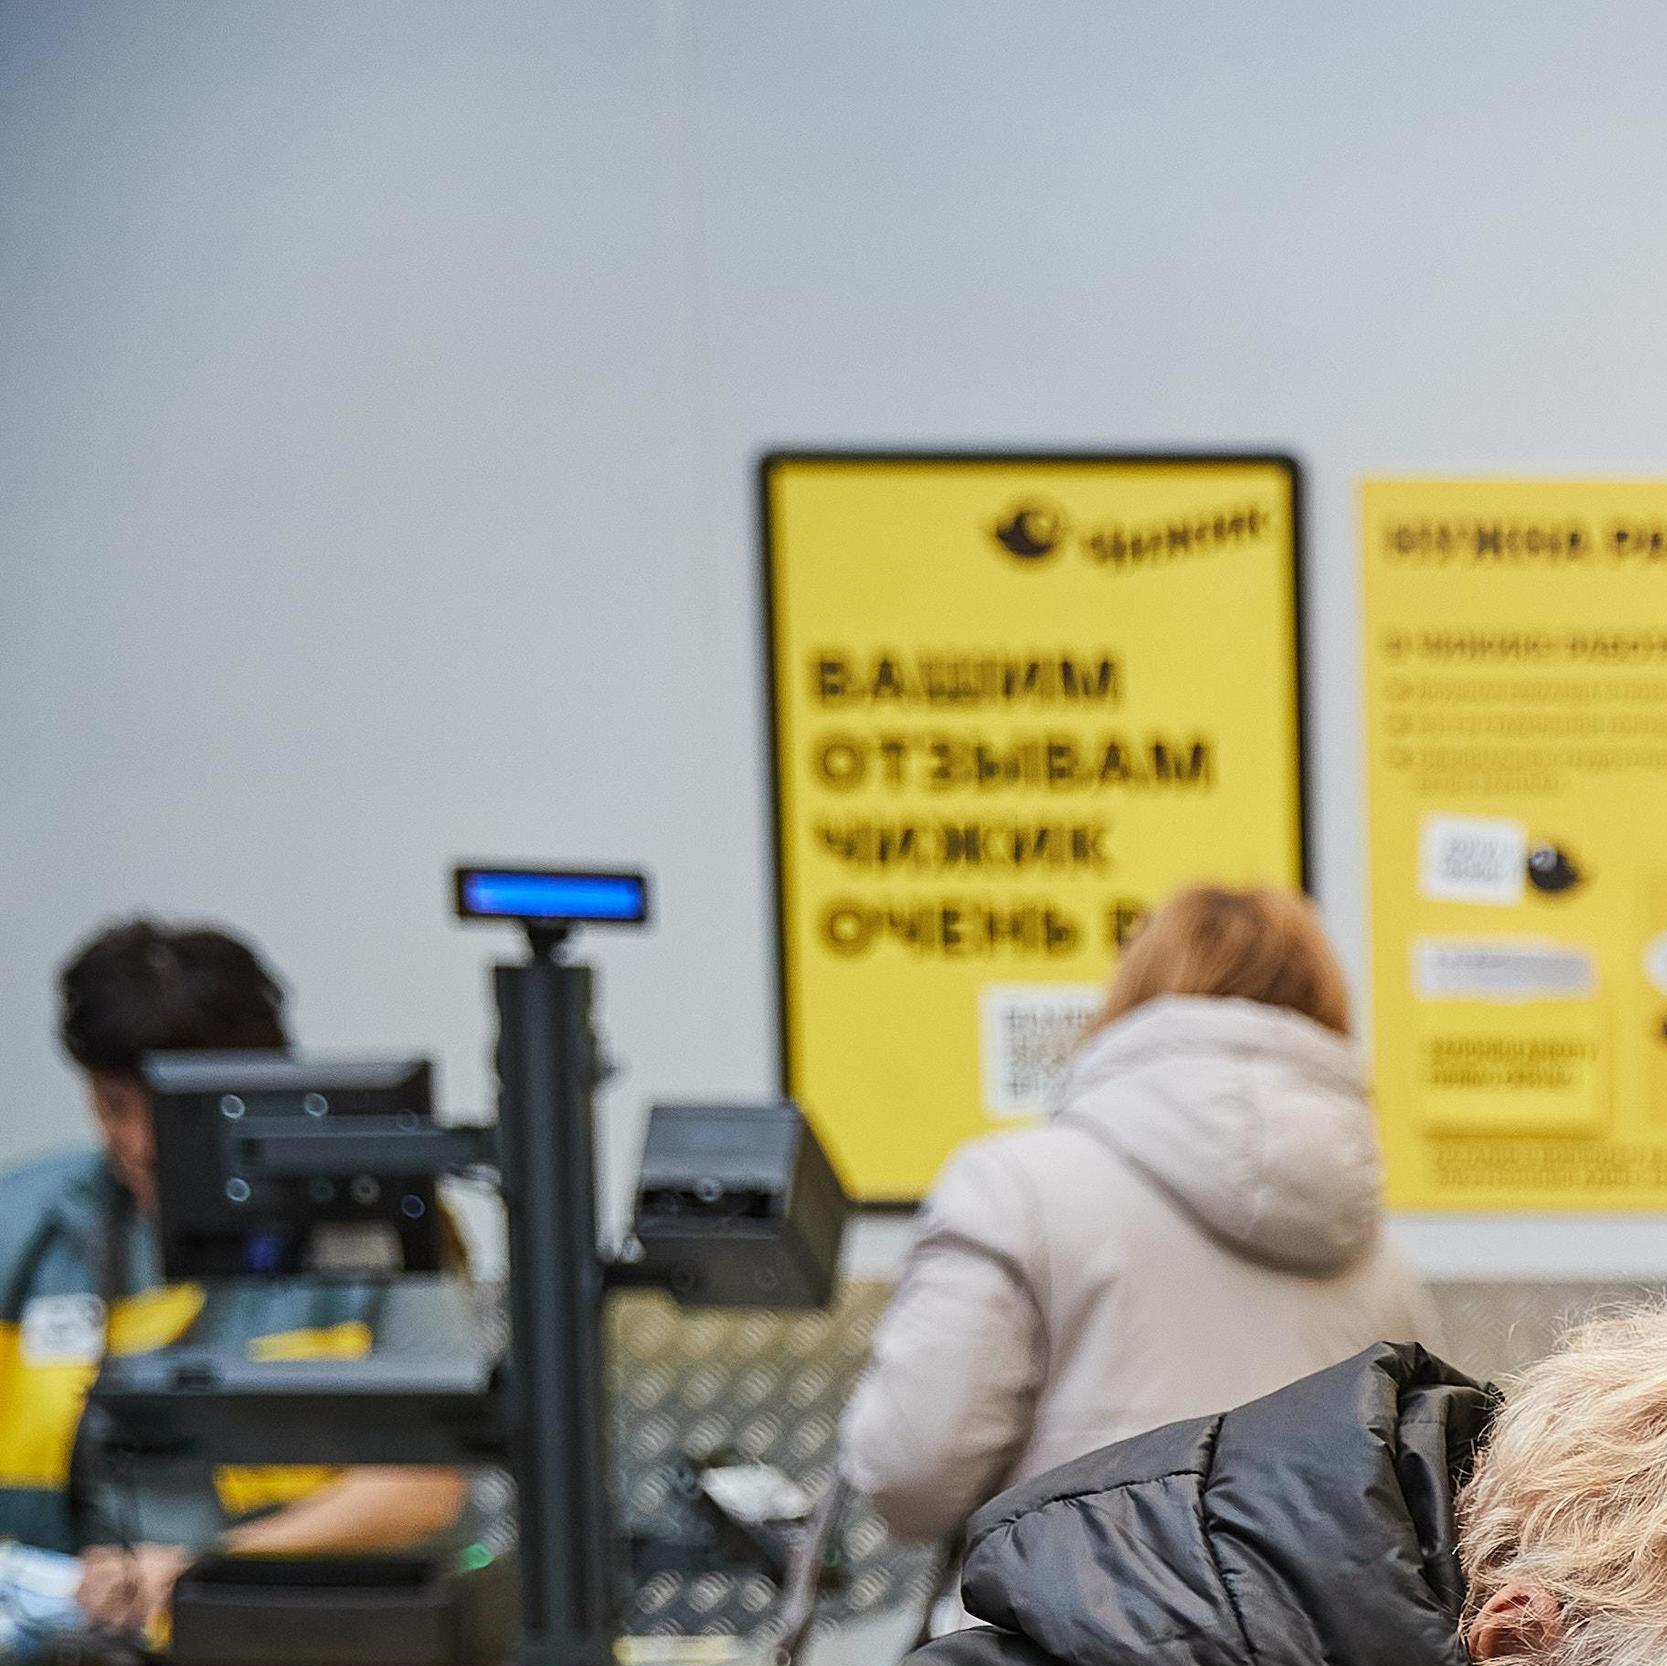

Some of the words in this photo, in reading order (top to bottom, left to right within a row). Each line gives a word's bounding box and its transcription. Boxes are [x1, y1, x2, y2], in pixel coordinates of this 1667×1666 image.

[815, 651, 1124, 704] ВАШИМ
[815, 735, 1216, 790] ОТЗЫВАМ
[815, 821, 1112, 872] ЧИЖИК
[820, 902, 1084, 957] ОЧЕНЬ
